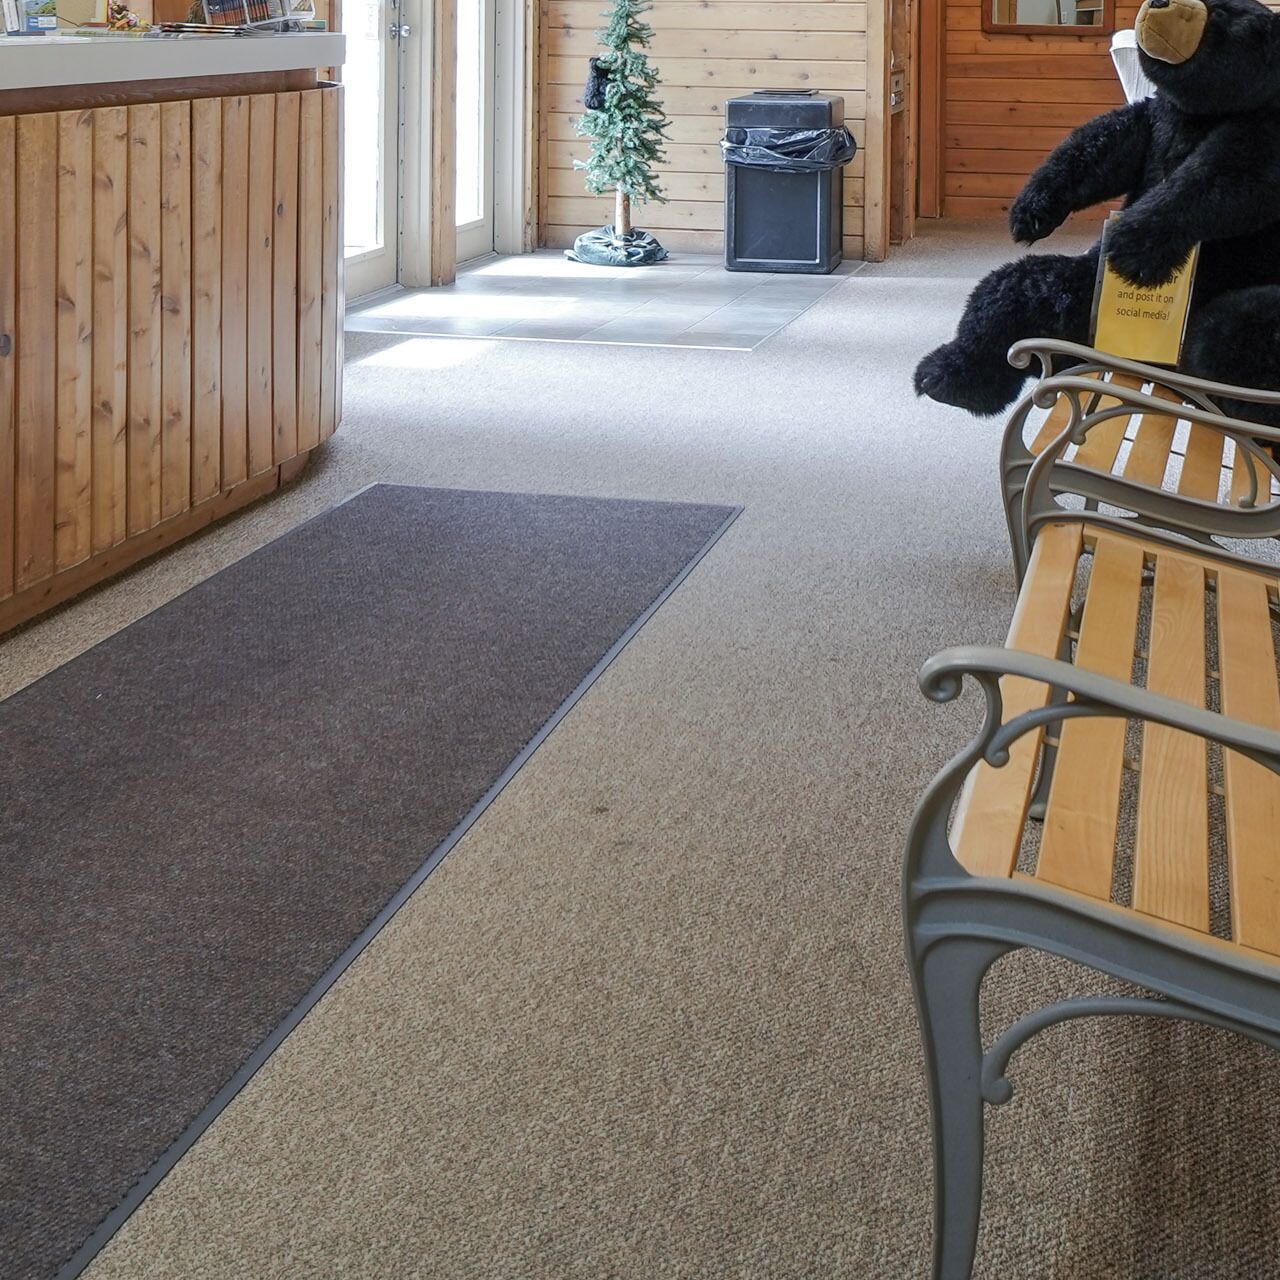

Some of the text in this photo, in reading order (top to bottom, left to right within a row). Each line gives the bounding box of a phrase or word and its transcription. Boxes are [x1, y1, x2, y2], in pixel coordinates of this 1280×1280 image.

[1117, 290, 1134, 300] and
[1136, 294, 1153, 302] post
[1156, 293, 1163, 303] it
[1116, 308, 1169, 320] social media!
